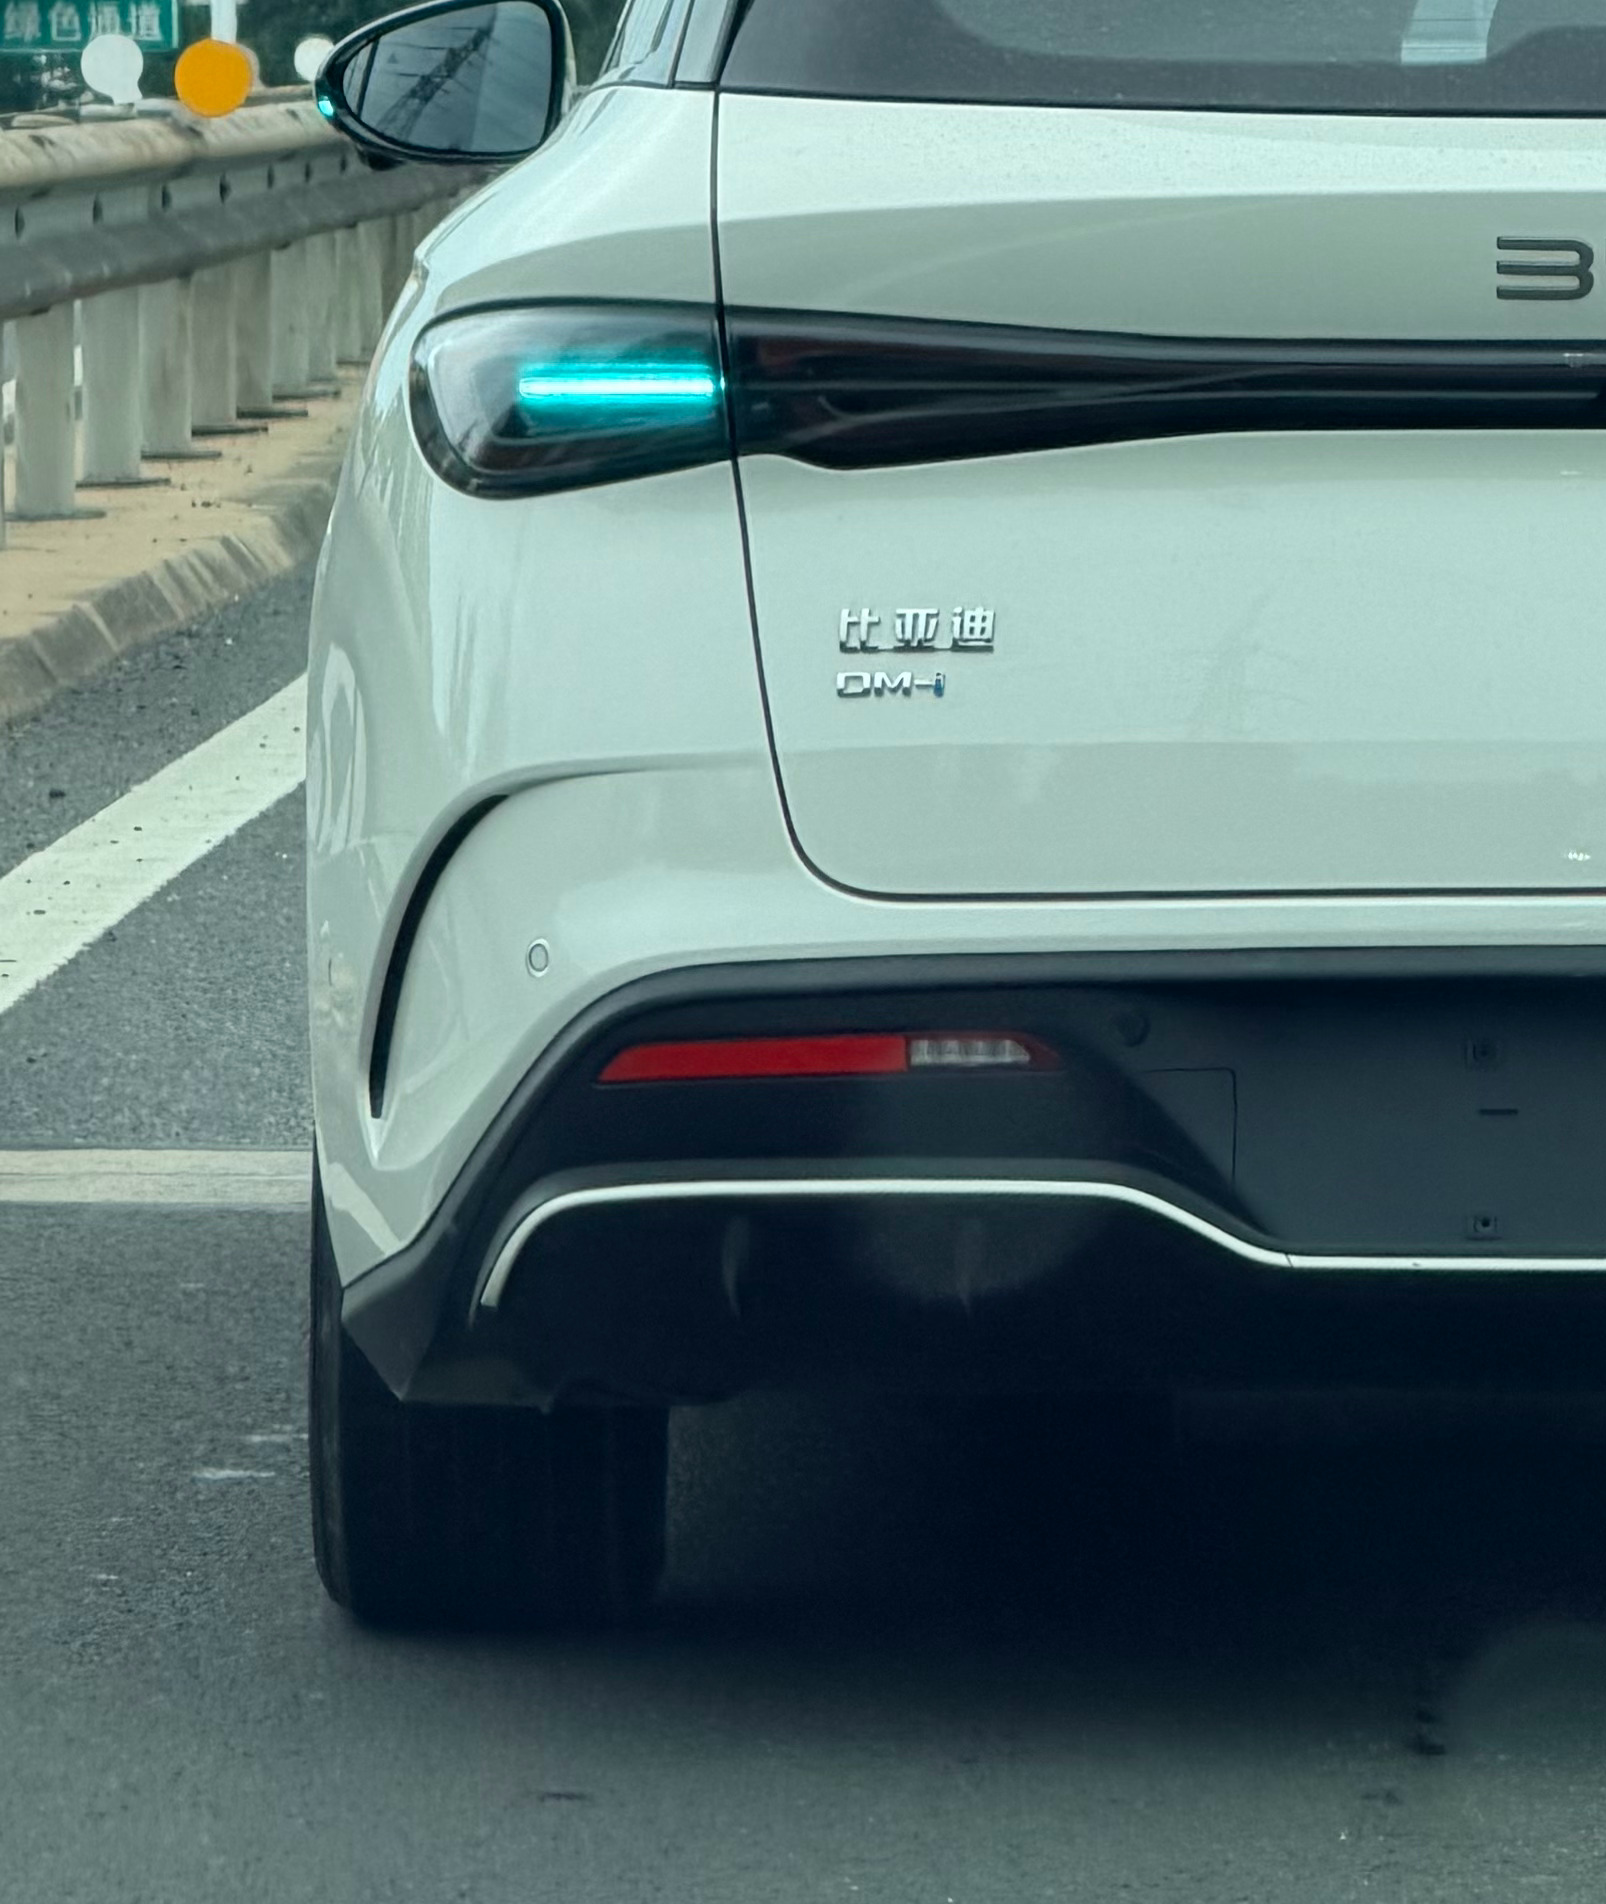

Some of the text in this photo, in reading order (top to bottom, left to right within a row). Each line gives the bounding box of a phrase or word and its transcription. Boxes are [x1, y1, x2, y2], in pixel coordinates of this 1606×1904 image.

[839, 607, 995, 653] 比亚迪
[836, 670, 946, 698] DM-i
